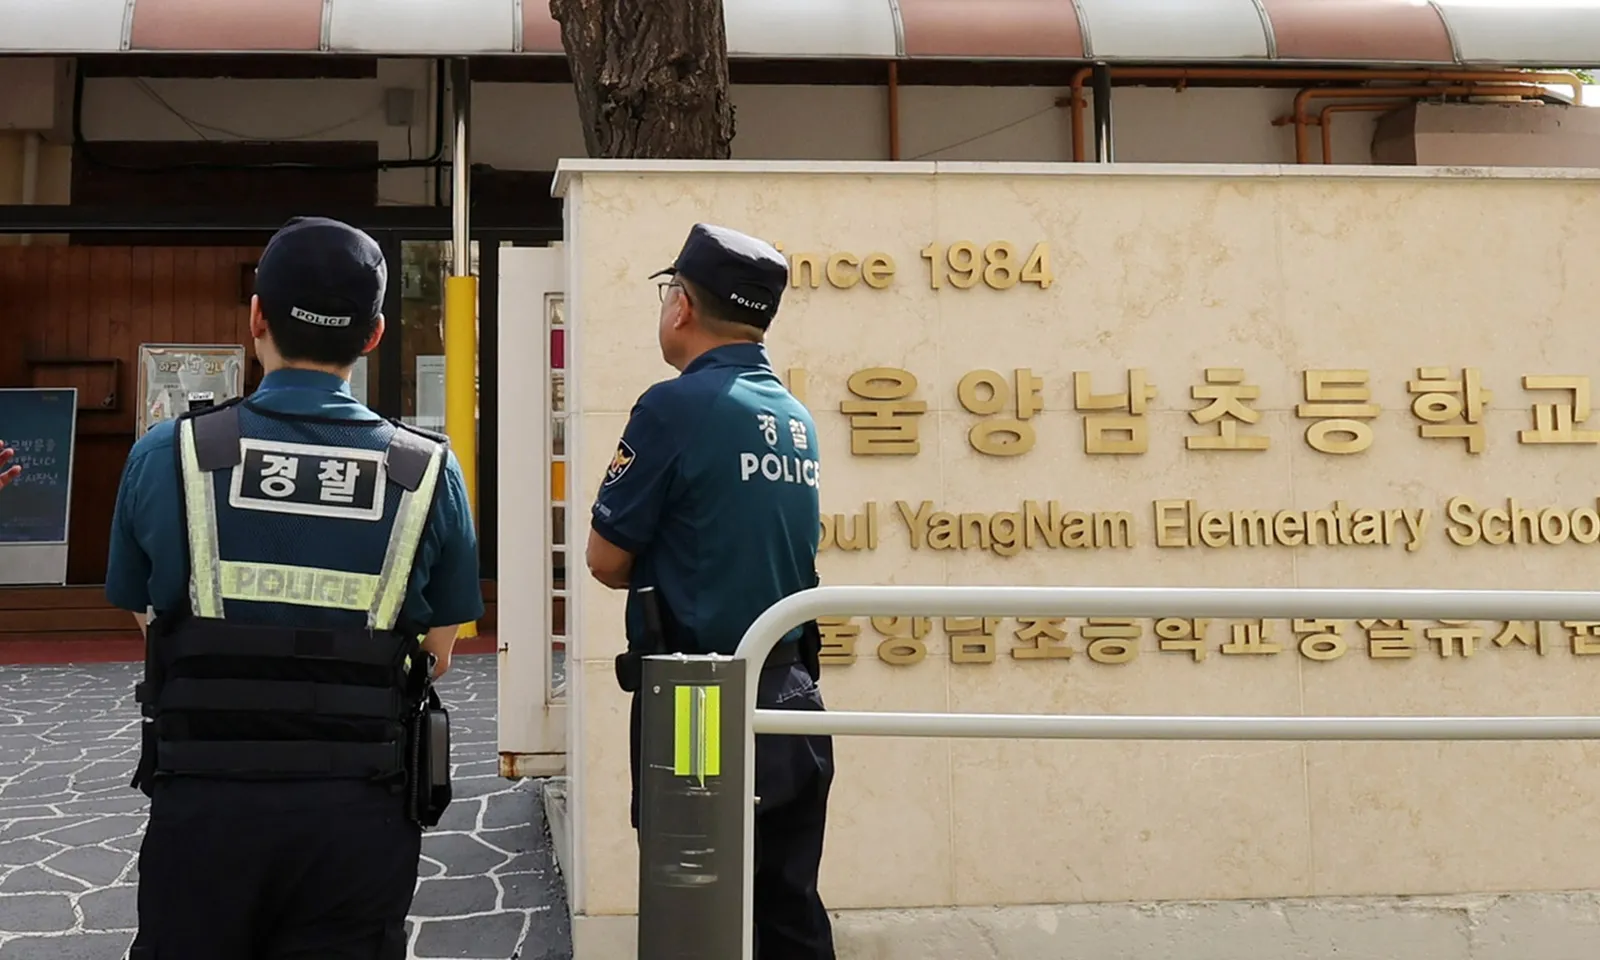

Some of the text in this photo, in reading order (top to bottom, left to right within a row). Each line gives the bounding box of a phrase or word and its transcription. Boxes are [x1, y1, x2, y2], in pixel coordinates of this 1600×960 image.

[920, 239, 1053, 290] 1984
[295, 309, 349, 326] POLICE
[730, 292, 768, 311] POLICE
[787, 365, 1600, 457] 울양남초등학교
[259, 454, 361, 503] 경찰
[895, 499, 1135, 557] YangNam
[1152, 499, 1432, 552] Elementary
[1446, 494, 1600, 547] Schoo
[235, 566, 361, 605] POLICE
